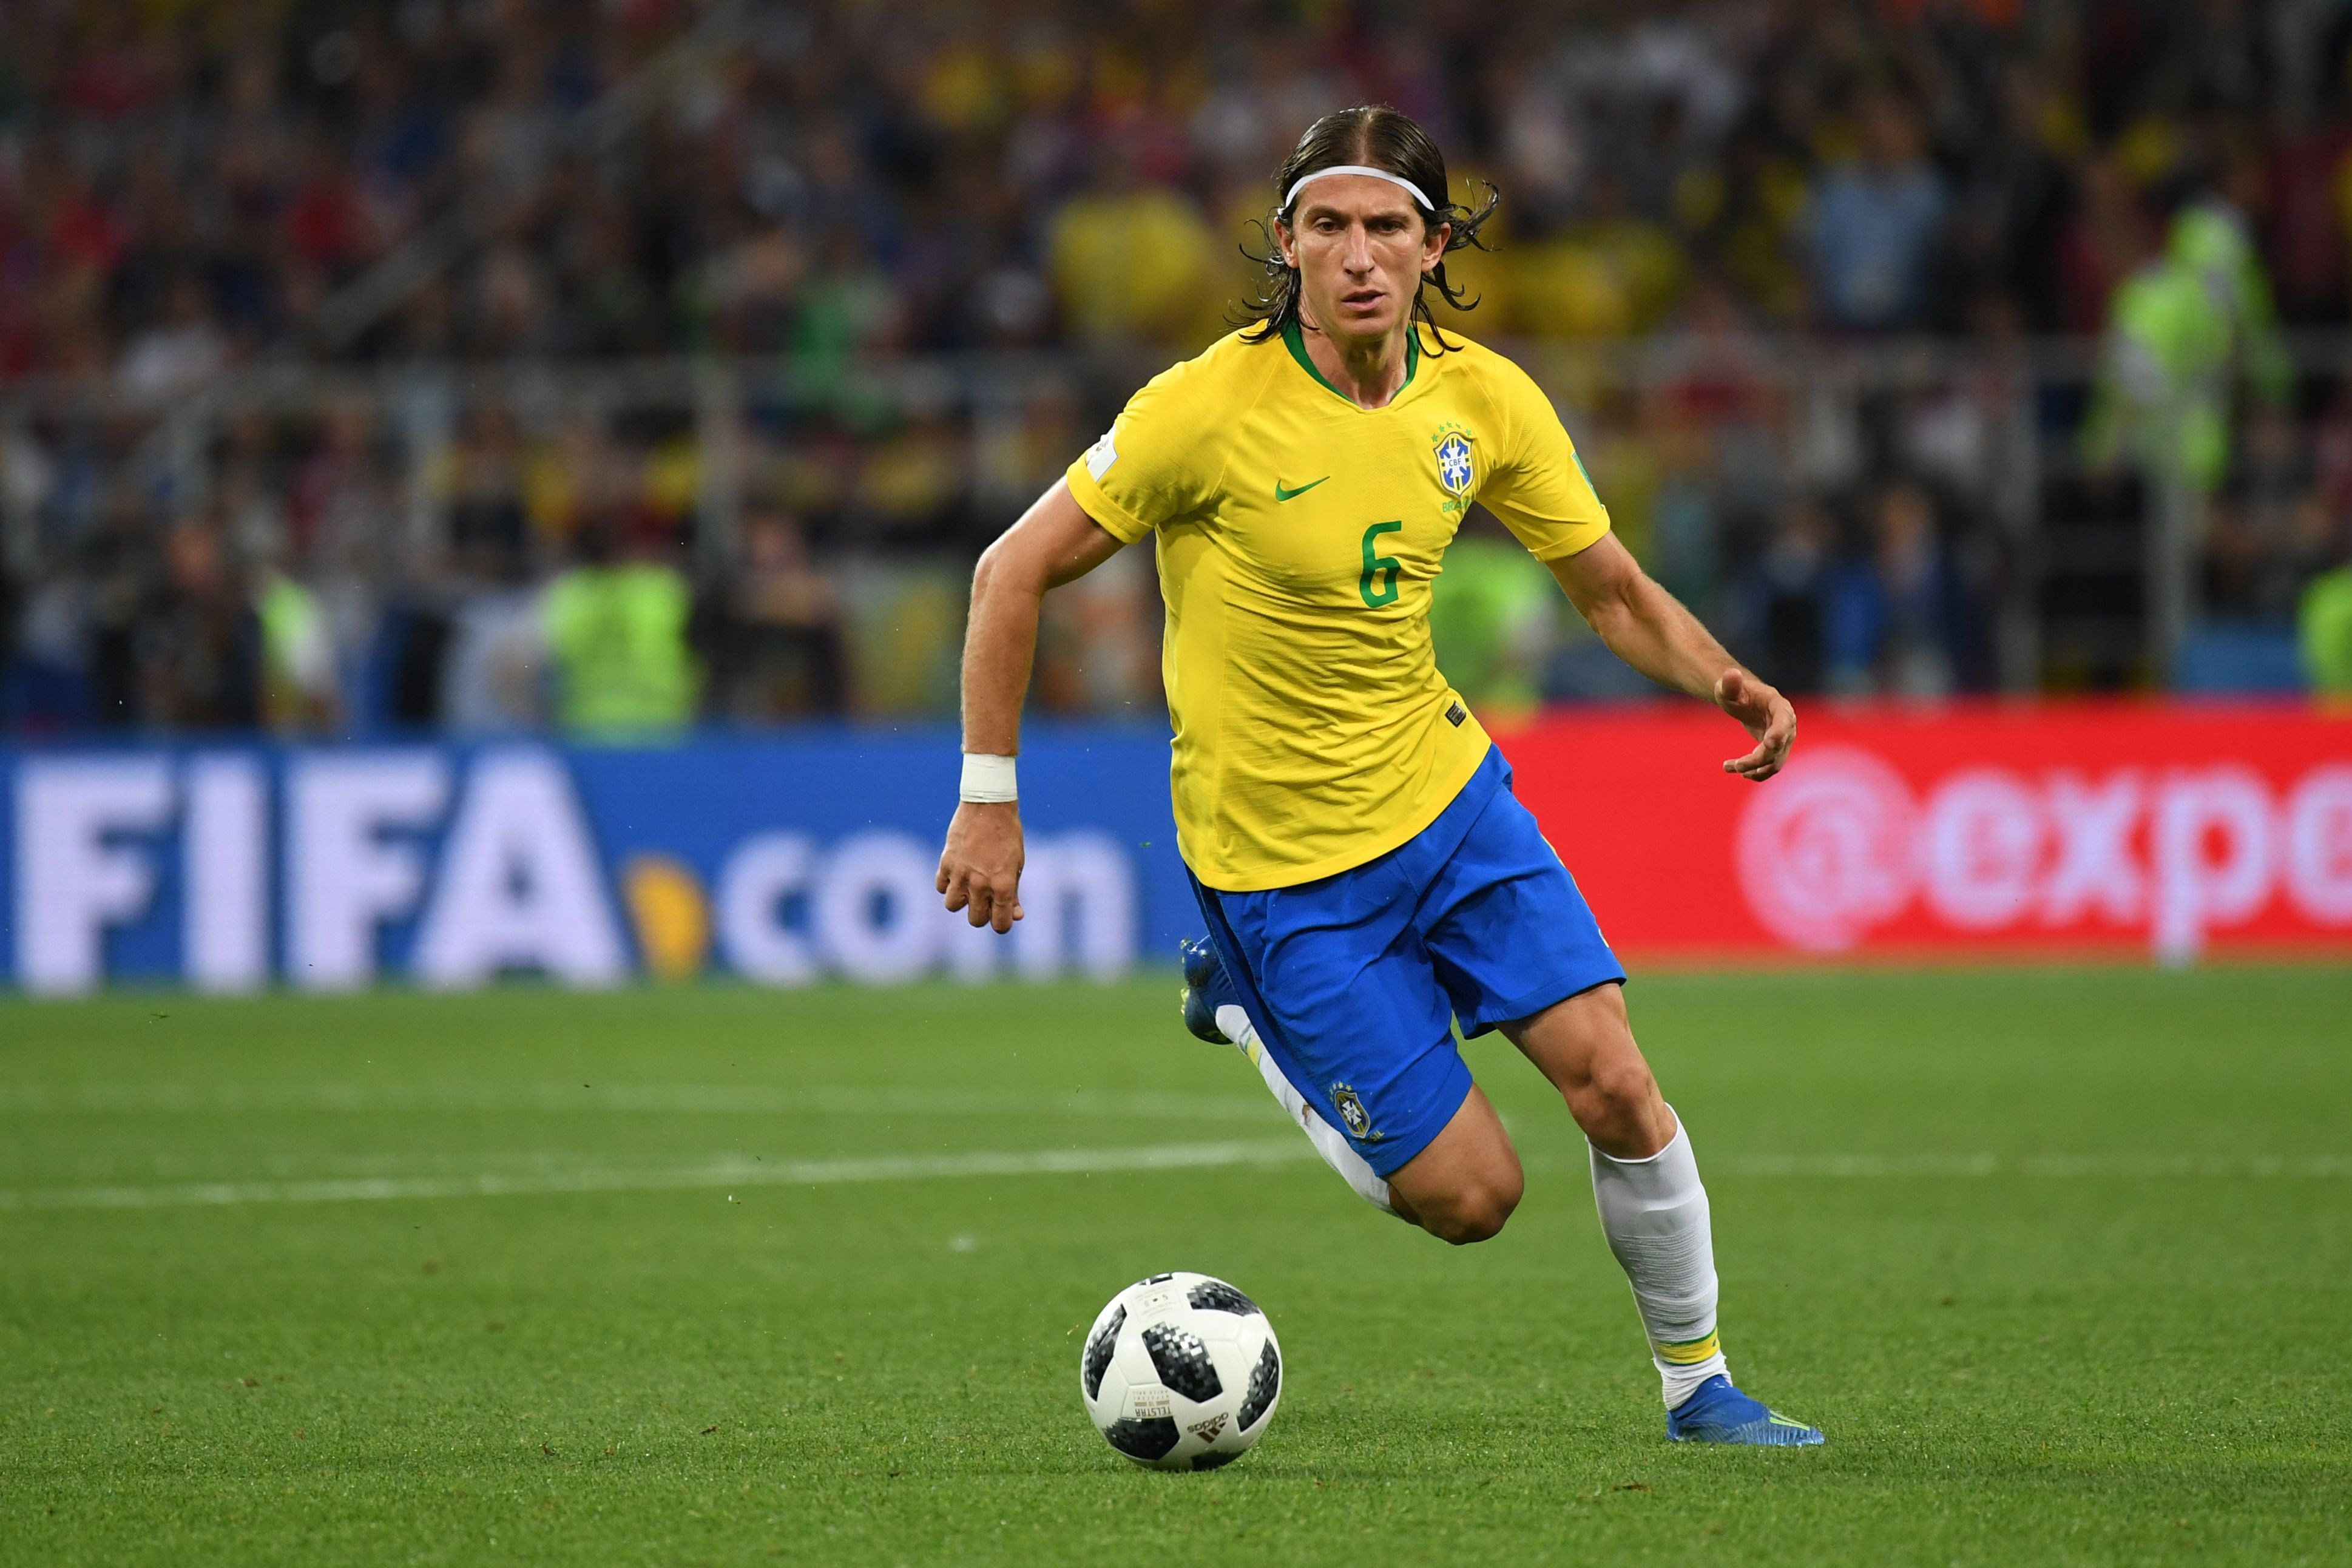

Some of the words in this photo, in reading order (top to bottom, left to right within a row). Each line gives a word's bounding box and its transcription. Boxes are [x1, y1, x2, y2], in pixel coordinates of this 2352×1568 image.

[1448, 458, 1462, 467] CBF
[1359, 520, 1402, 609] 6
[1135, 1406, 1171, 1417] TELSTAR
[1187, 1411, 1229, 1433] adidas
